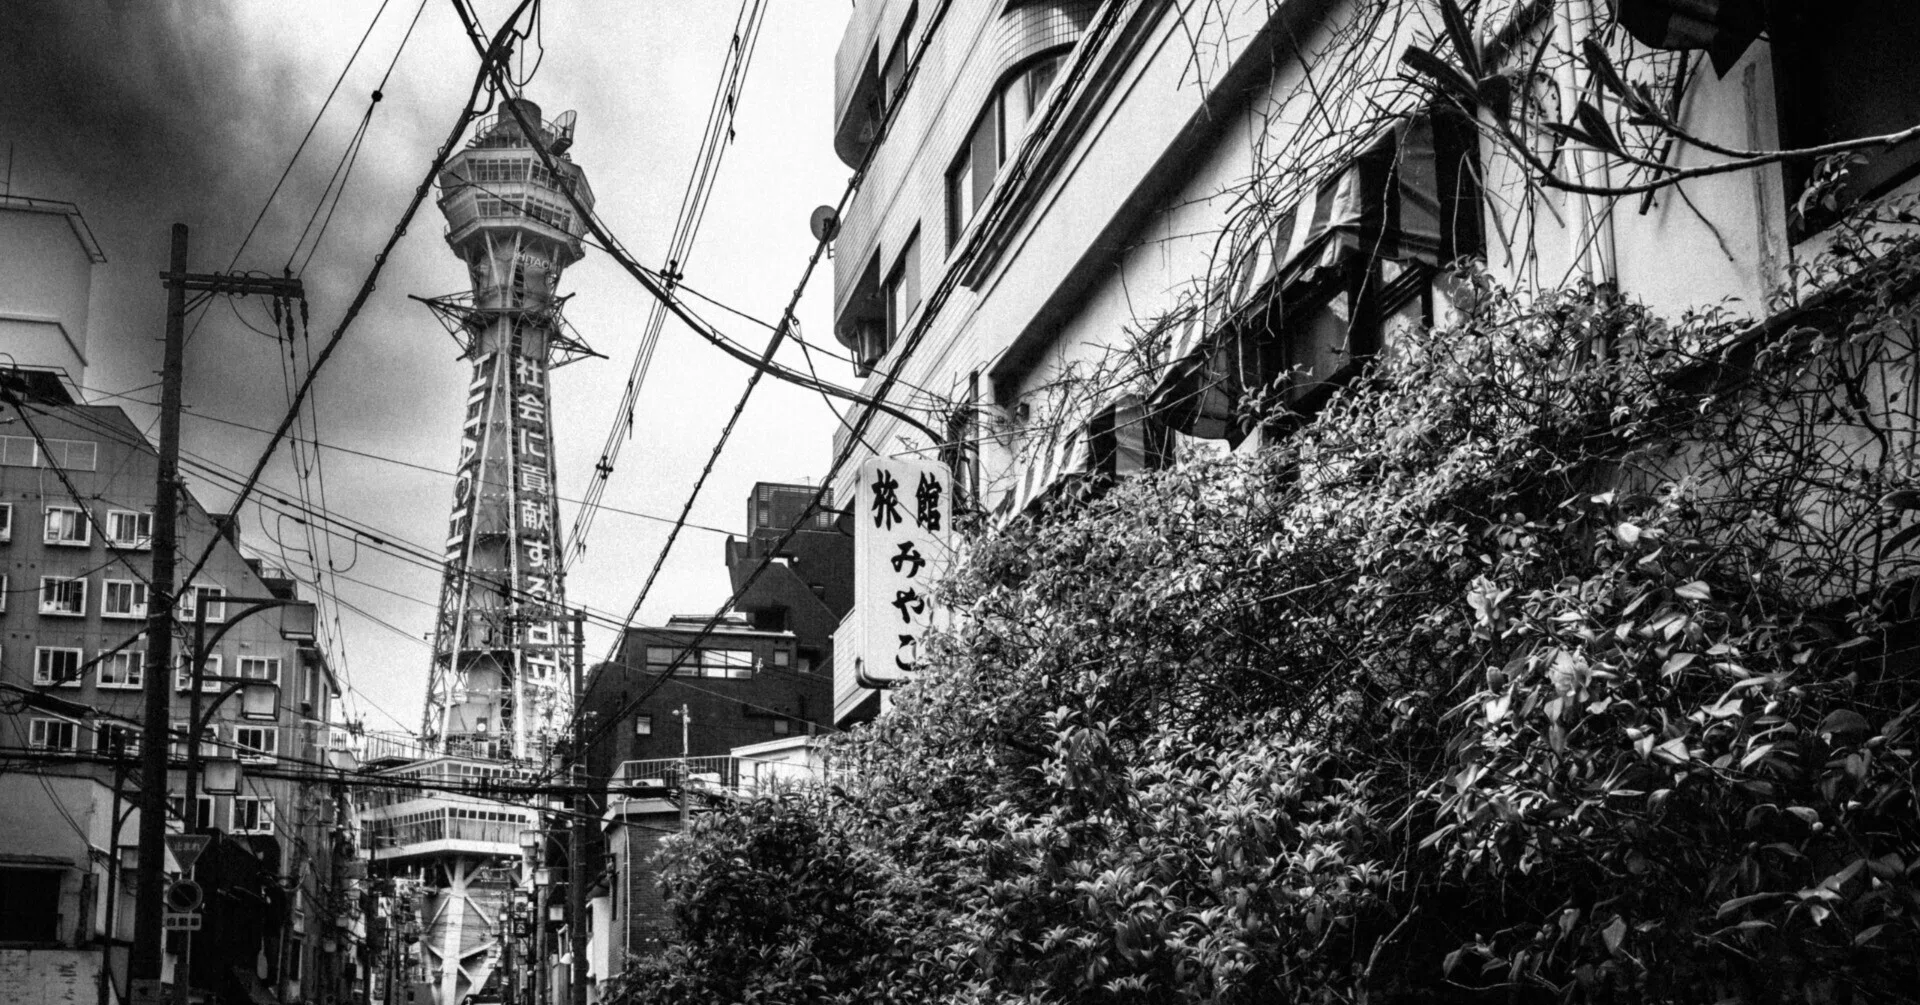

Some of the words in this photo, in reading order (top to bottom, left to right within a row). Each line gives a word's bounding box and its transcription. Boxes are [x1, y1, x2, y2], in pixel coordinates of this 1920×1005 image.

[443, 352, 490, 563] HITACHI
[872, 469, 942, 533] 旅館
[891, 541, 926, 671] みやこ
